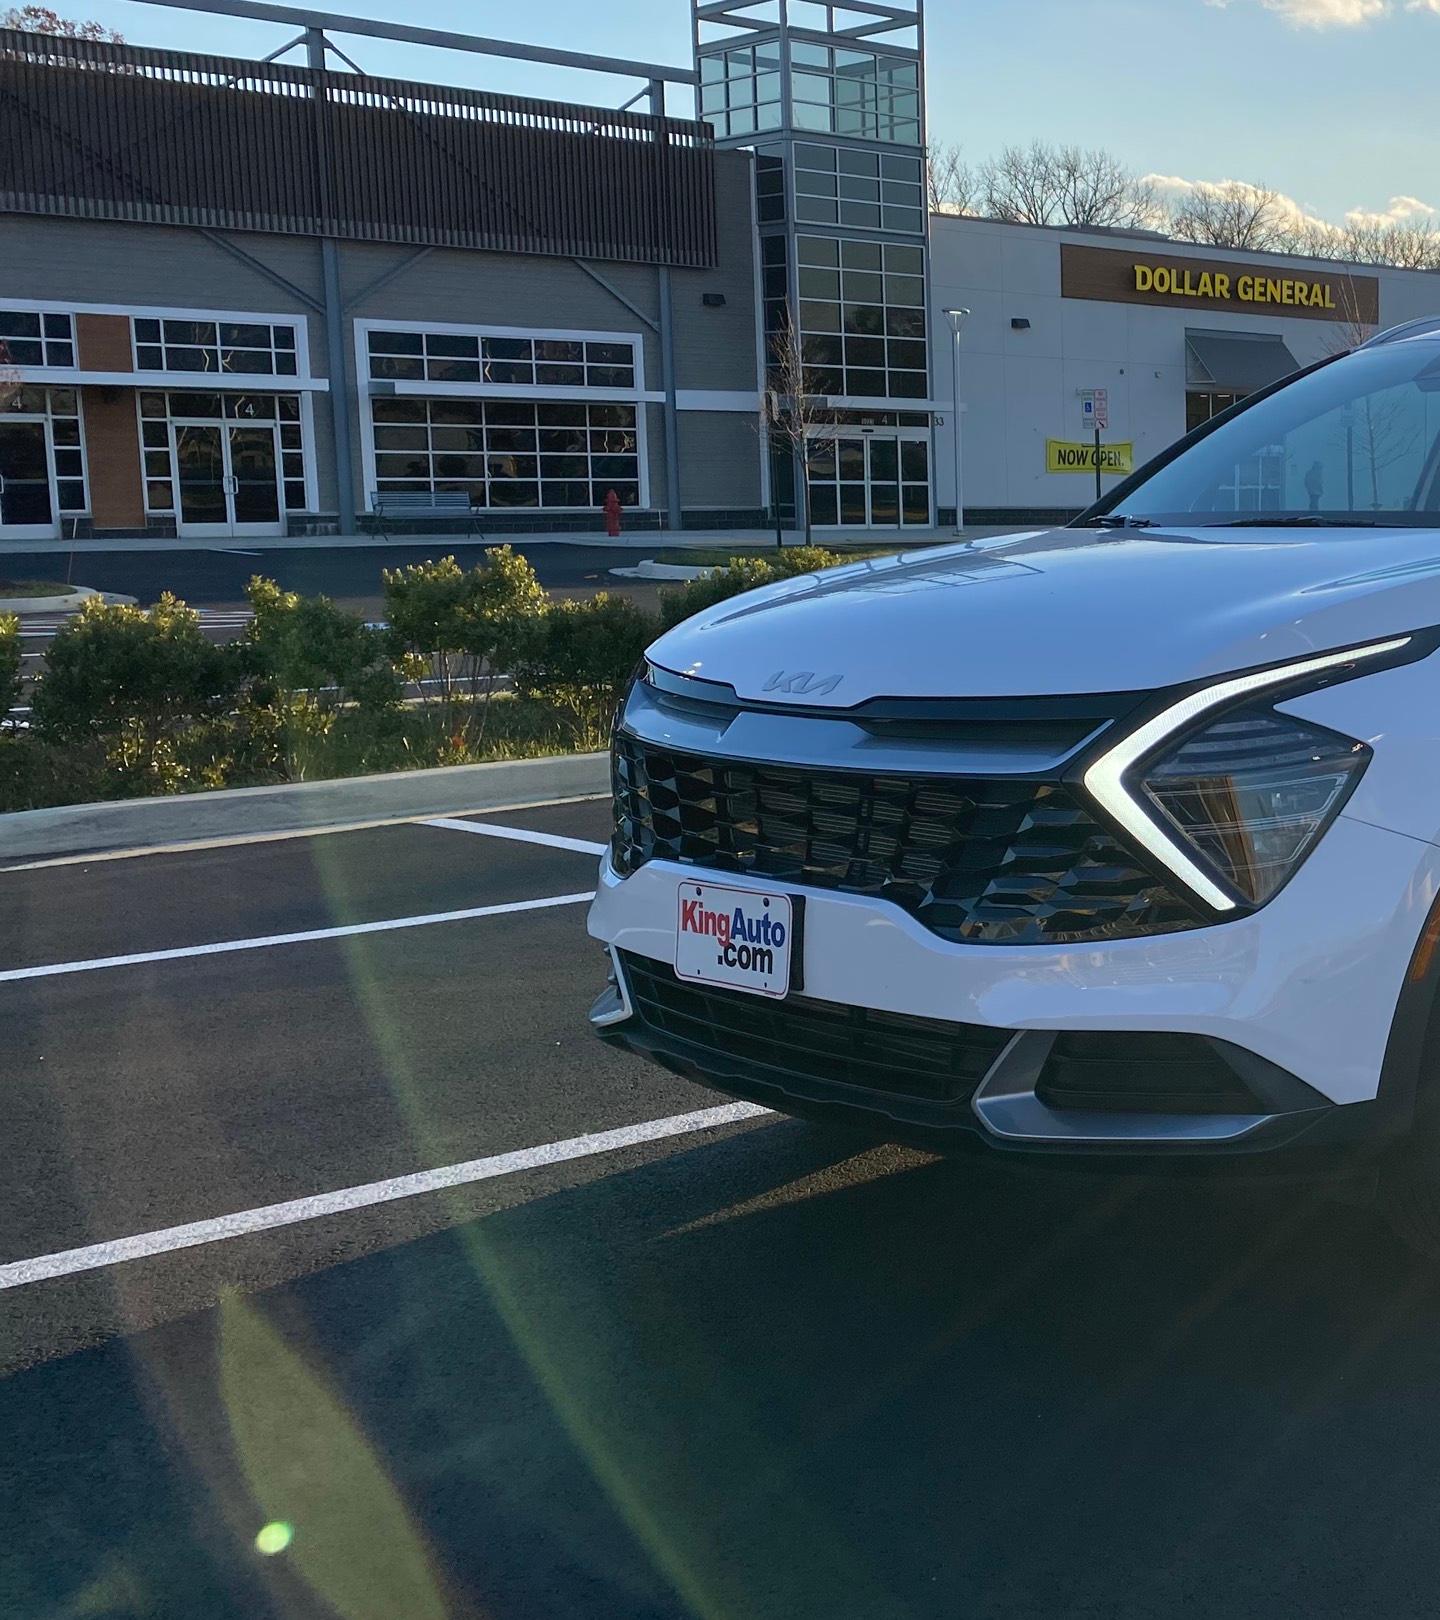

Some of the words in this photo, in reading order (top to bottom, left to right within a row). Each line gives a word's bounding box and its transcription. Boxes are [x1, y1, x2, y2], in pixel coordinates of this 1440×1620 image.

[1134, 264, 1231, 299] DOLLAR
[1238, 275, 1336, 308] GENERAL
[245, 403, 255, 416] 4
[1057, 449, 1089, 466] NOW
[761, 670, 844, 696] KIA
[682, 899, 786, 948] KingAuto
[717, 942, 773, 975] .com
